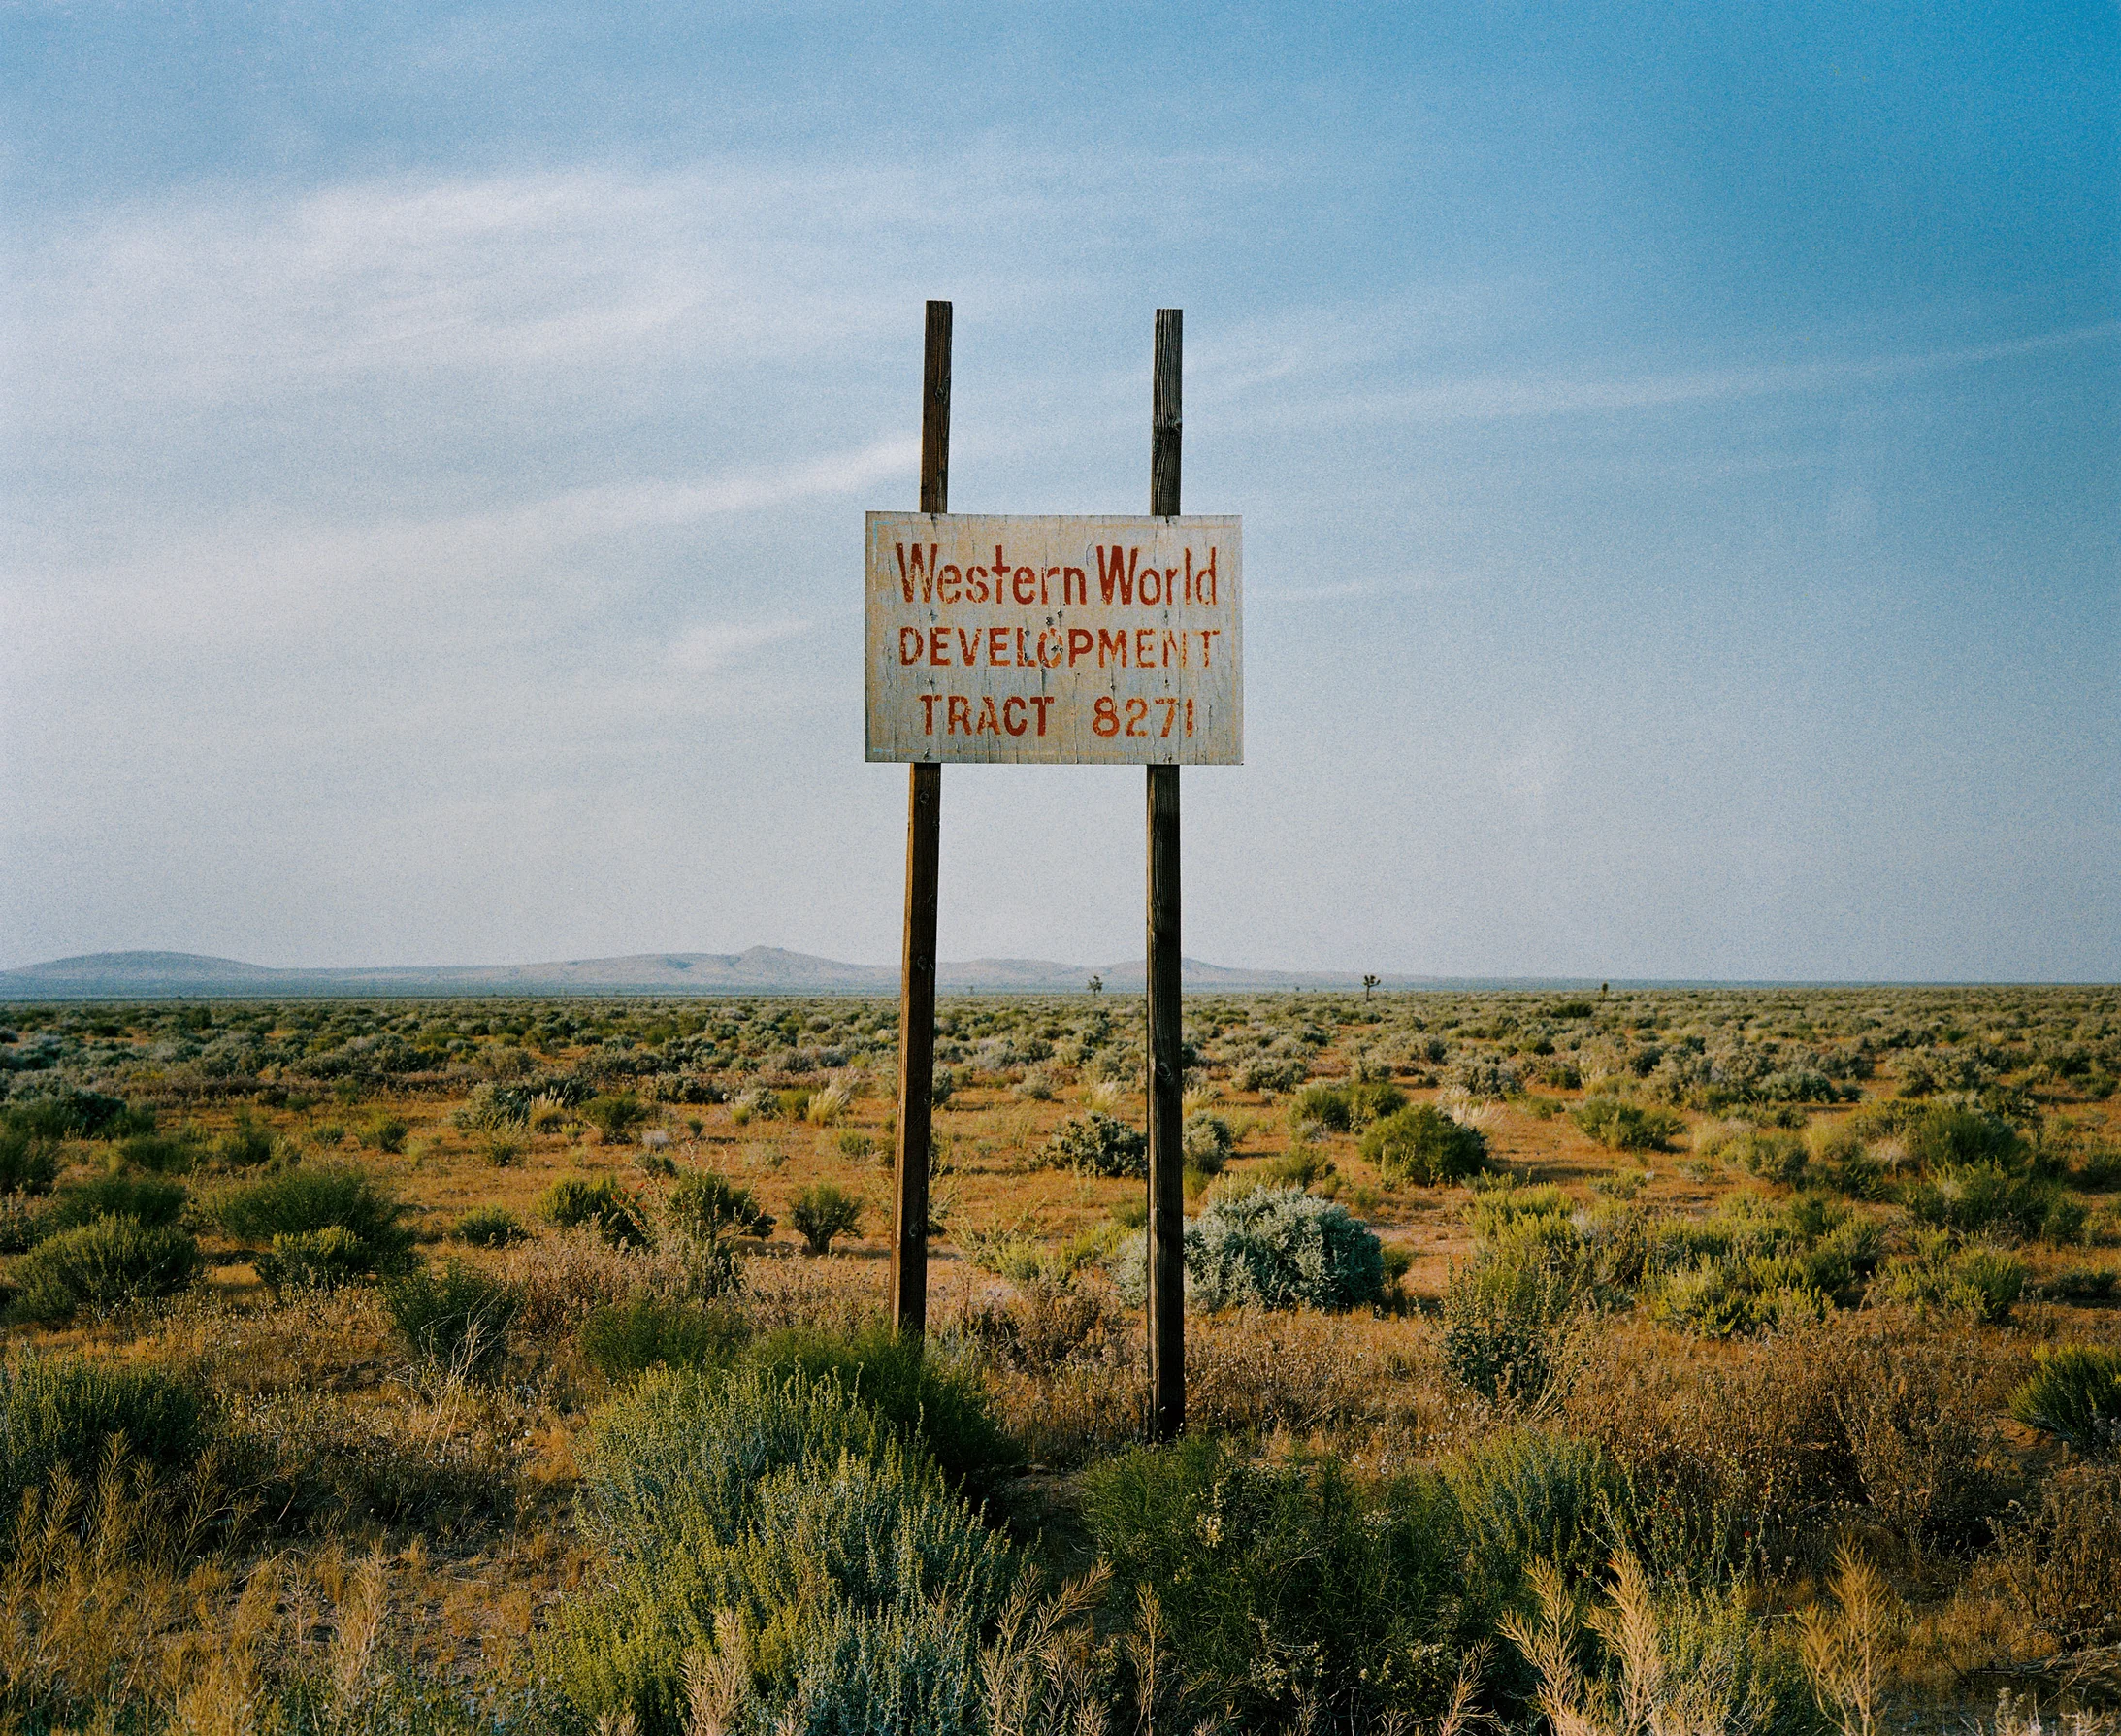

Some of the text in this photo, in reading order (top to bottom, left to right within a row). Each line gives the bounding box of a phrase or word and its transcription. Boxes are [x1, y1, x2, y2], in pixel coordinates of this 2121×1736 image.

[895, 542, 1218, 606] Western World
[898, 626, 1222, 669] DEVELOPMENT
[919, 694, 1193, 737] TRACT 8271
